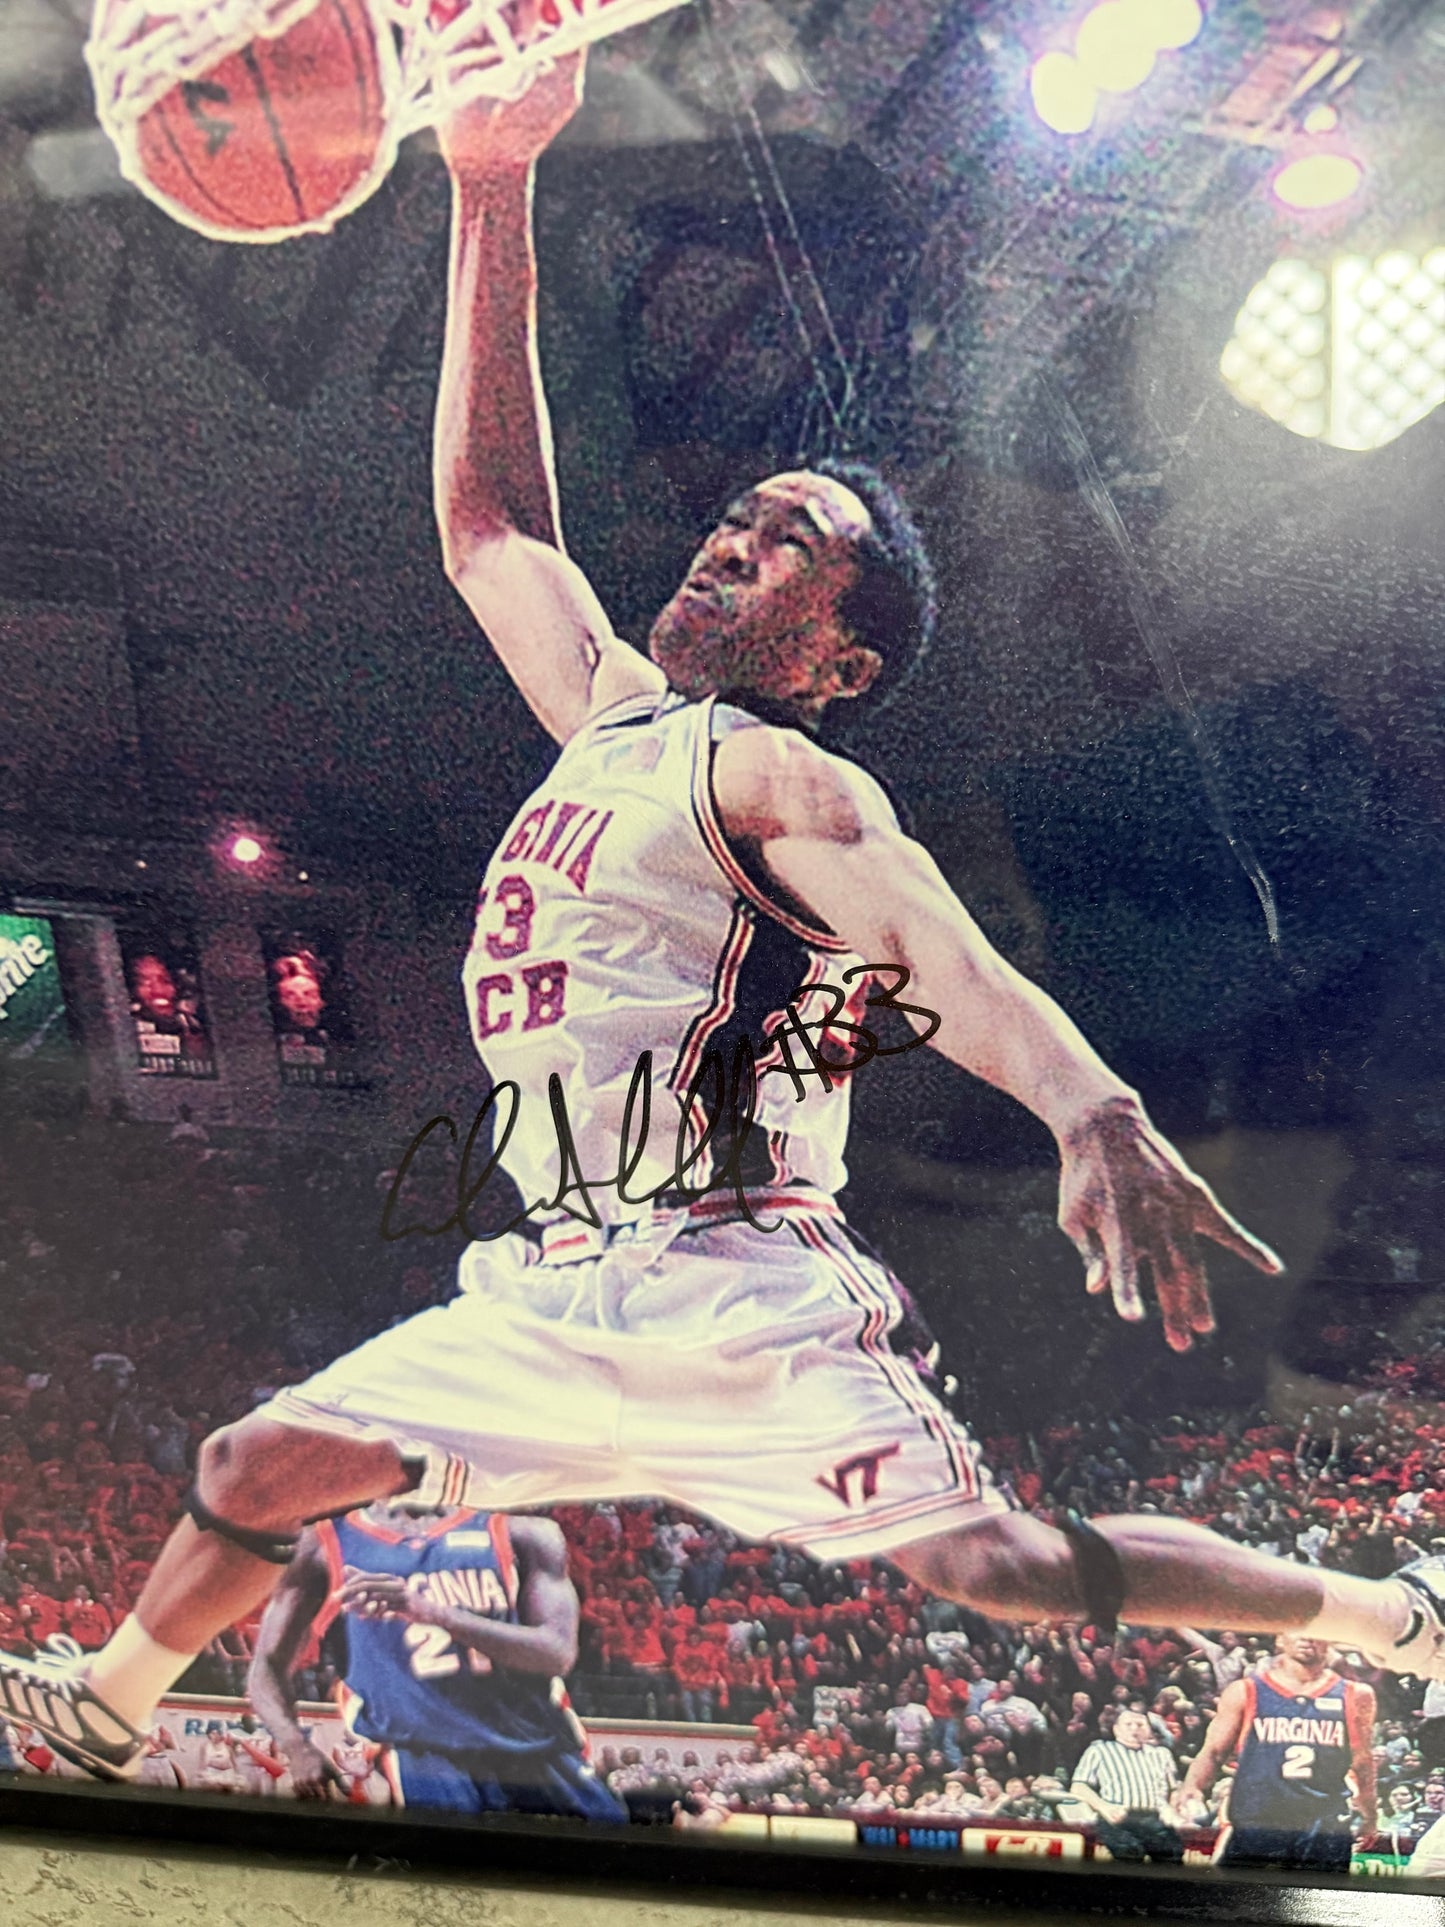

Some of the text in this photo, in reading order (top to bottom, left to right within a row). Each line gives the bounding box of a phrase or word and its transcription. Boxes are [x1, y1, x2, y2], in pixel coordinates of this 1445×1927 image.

[813, 1440, 901, 1510] VT
[1253, 1716, 1345, 1748] VIRGINIA
[1281, 1744, 1316, 1780] 2
